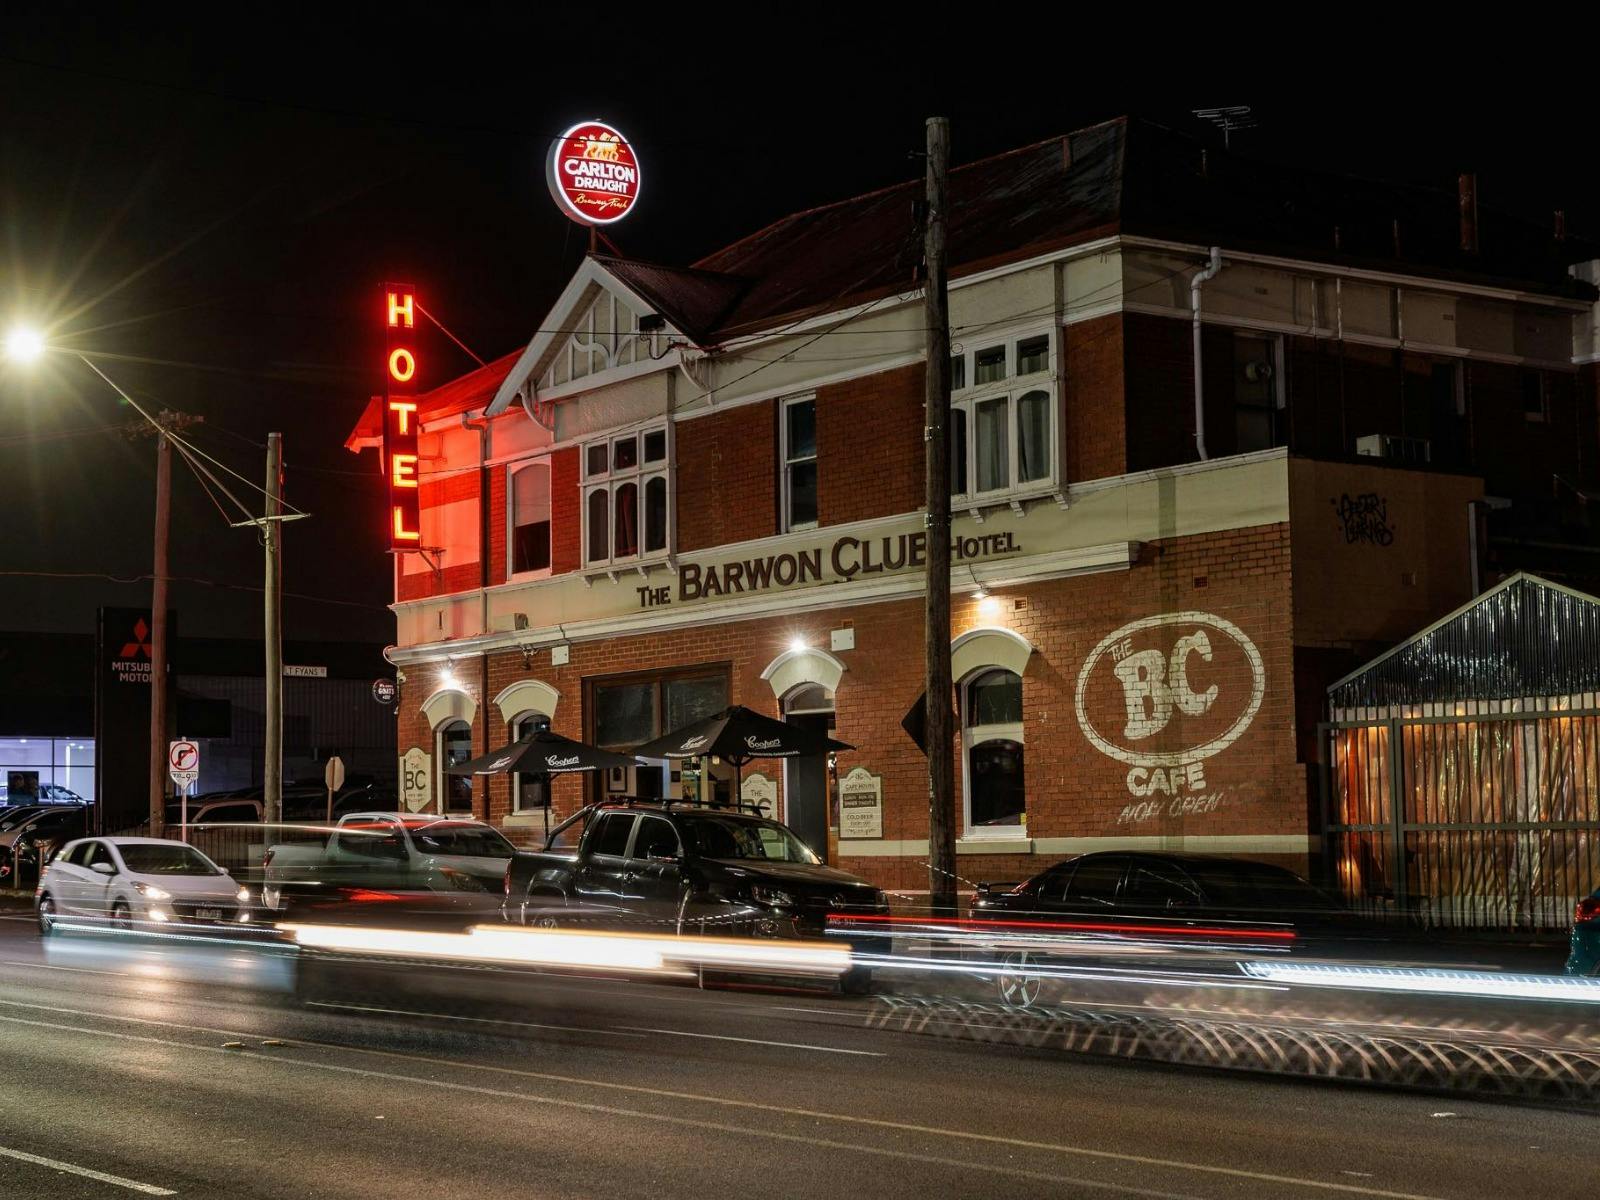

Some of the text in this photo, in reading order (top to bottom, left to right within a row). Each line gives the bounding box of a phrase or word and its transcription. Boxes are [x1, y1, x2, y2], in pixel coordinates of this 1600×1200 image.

[564, 159, 636, 184] CARLTON
[574, 176, 629, 194] DRAUGHT
[388, 293, 420, 541] HOTEL
[636, 585, 671, 608] THE
[679, 556, 822, 602] BARWON
[1106, 638, 1135, 662] THE
[111, 660, 171, 673] MITSUBI
[295, 667, 319, 676] FYANS
[1113, 629, 1219, 741] BC
[744, 735, 783, 750] Coopers
[544, 754, 581, 767] Coopers
[405, 769, 426, 791] BC
[1126, 762, 1207, 797] CAFE
[751, 789, 763, 797] THE
